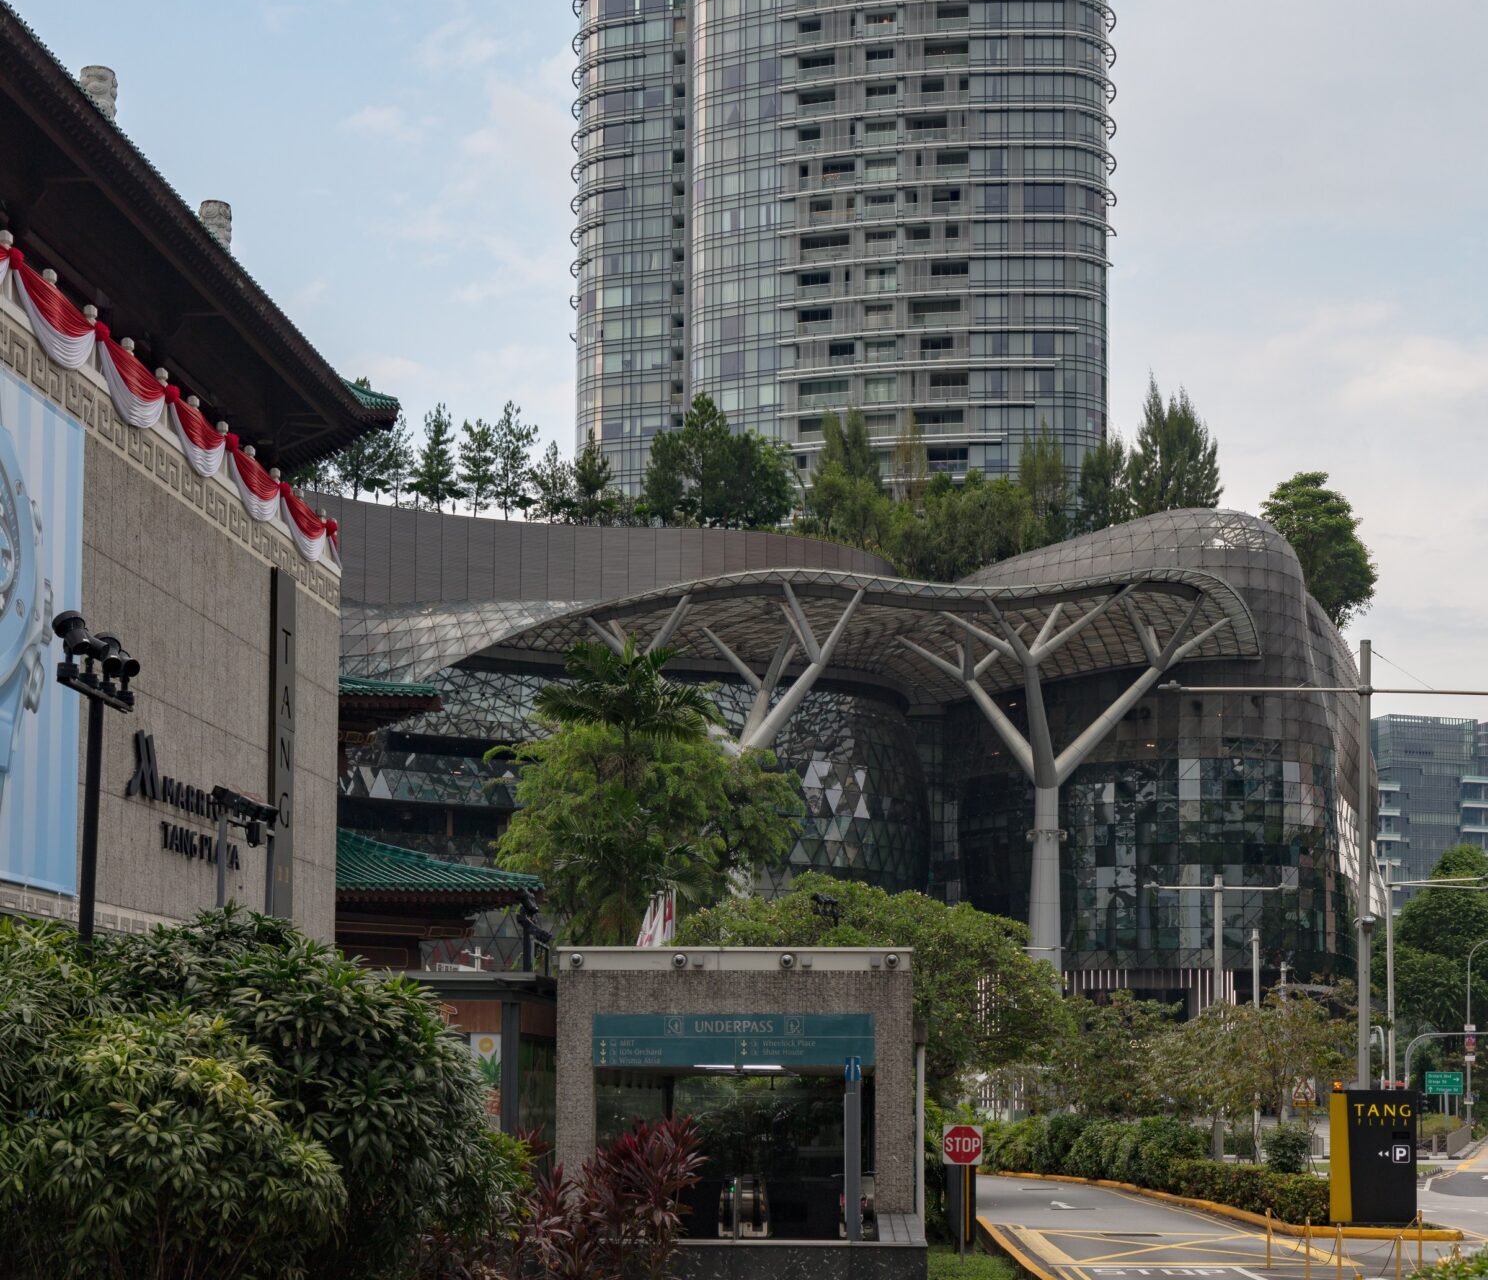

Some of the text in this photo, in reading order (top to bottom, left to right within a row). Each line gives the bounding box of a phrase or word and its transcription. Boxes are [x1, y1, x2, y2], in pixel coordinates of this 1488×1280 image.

[279, 627, 292, 829] TANG
[160, 820, 198, 858] TANG
[695, 1020, 774, 1034] UNDERPASS
[1353, 1104, 1412, 1118] TANG
[945, 1136, 981, 1153] STOP
[1092, 1268, 1227, 1276] STOP
